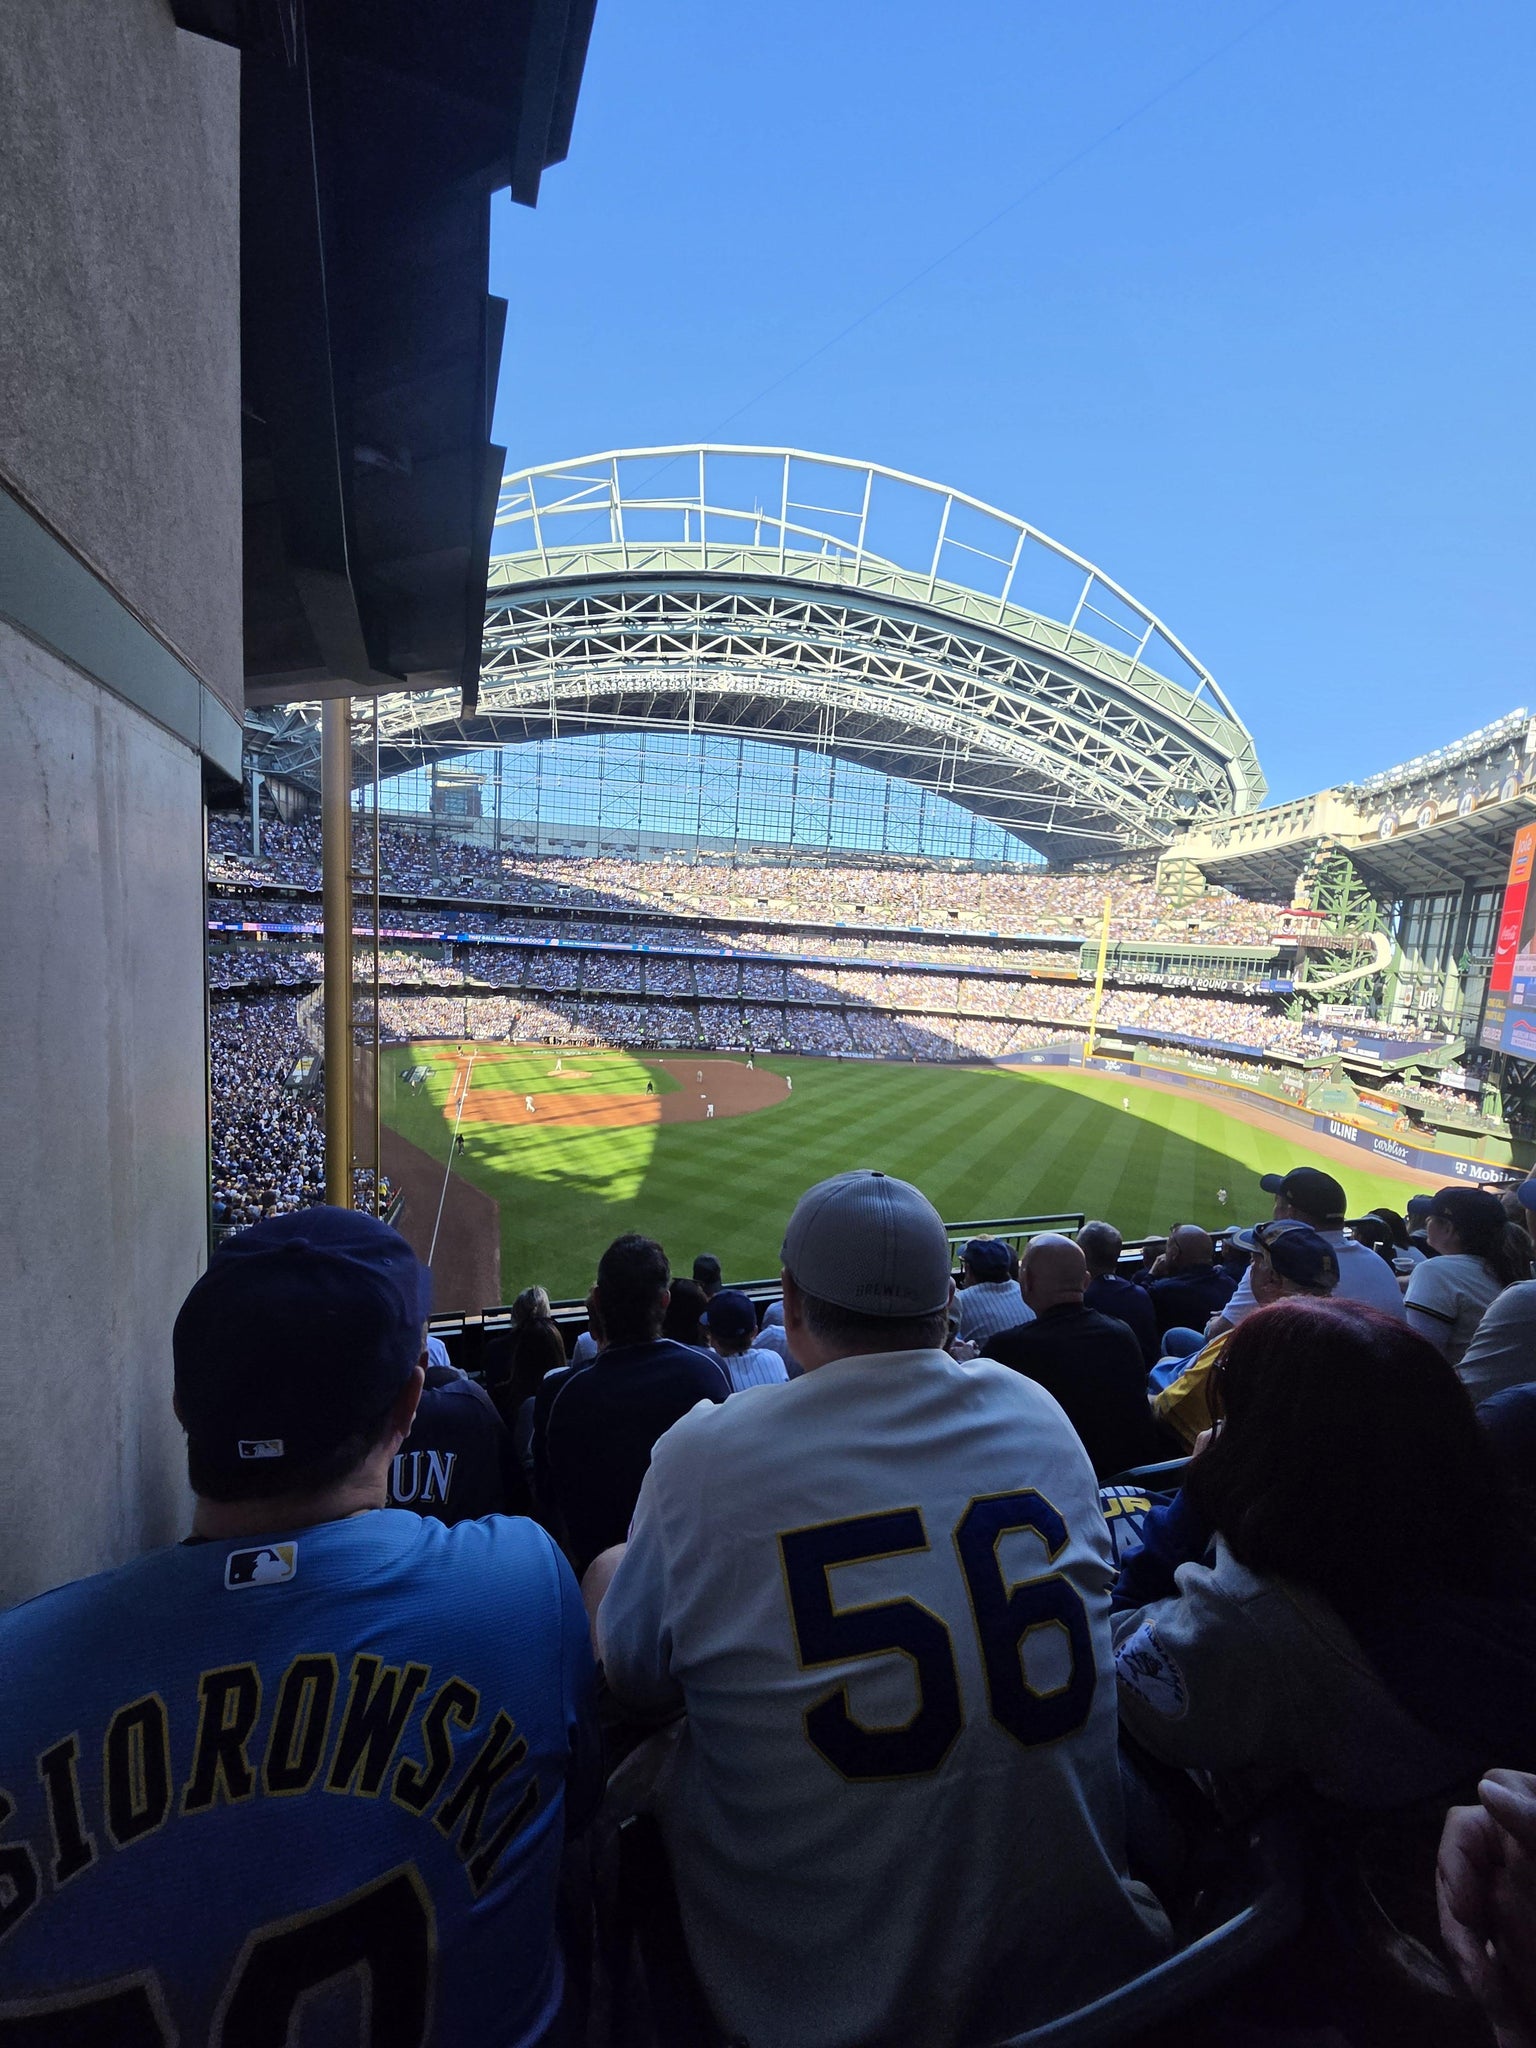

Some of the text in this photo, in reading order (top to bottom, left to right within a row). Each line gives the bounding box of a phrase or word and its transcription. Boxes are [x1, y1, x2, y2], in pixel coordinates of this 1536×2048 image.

[1134, 974, 1228, 990] OPEN YEAR ROUND
[1329, 1119, 1358, 1142] ULINE
[776, 1487, 1097, 1782] 56
